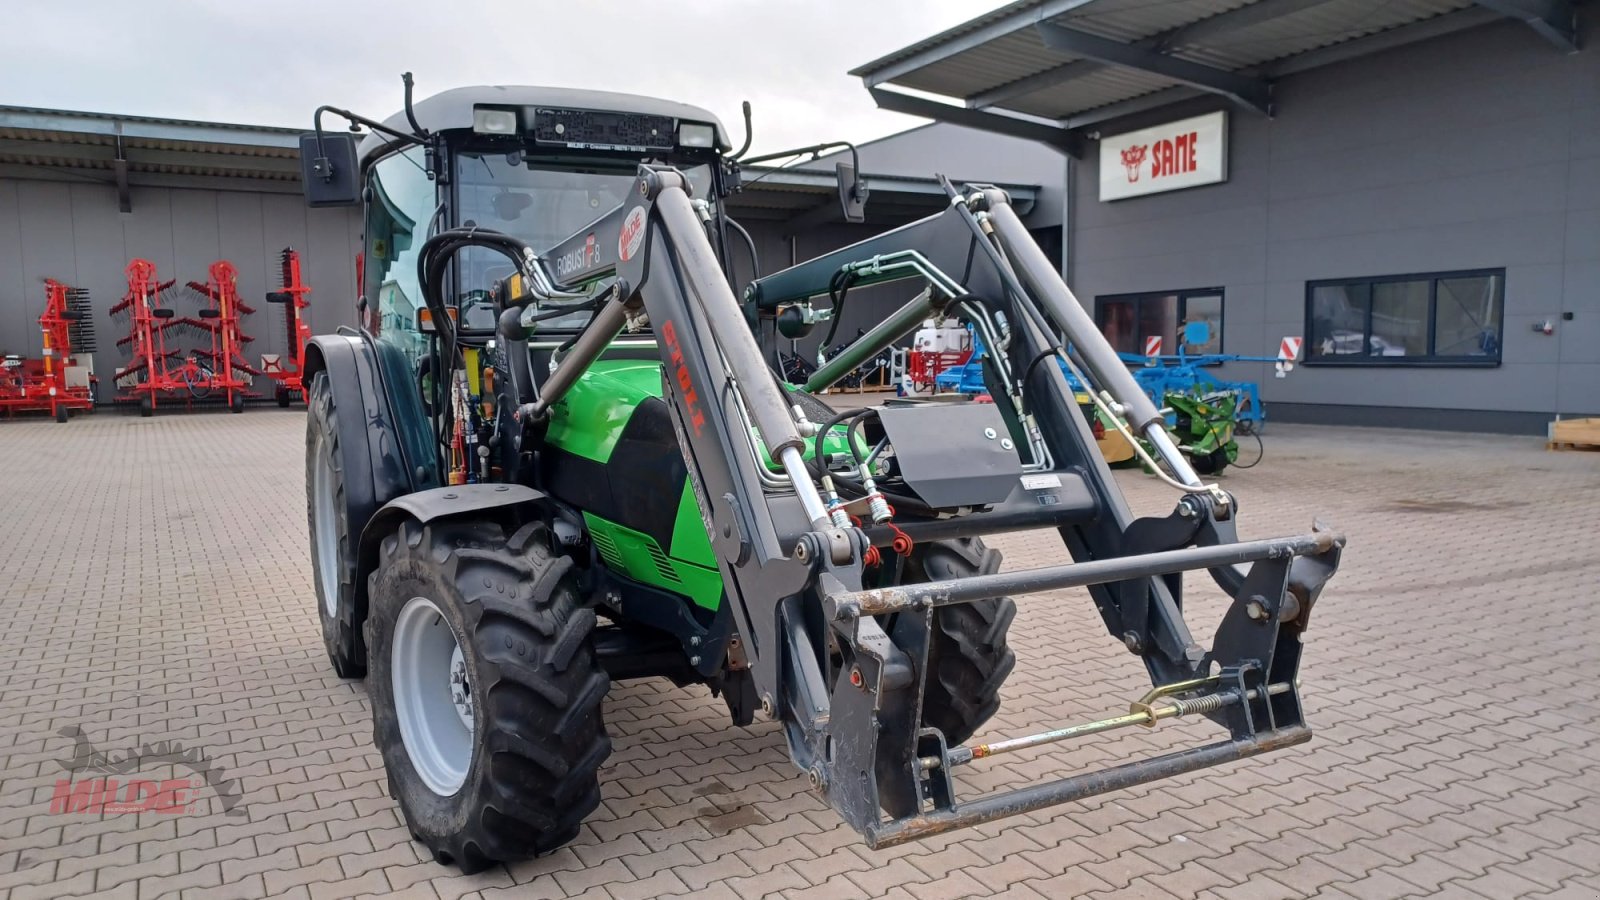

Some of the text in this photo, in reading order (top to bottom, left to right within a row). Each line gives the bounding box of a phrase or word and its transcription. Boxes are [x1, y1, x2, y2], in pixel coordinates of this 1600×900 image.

[1152, 132, 1197, 178] SAME
[620, 211, 641, 251] MILDE
[557, 245, 587, 276] ROBUST
[594, 244, 600, 263] 8
[662, 319, 705, 438] STOLL
